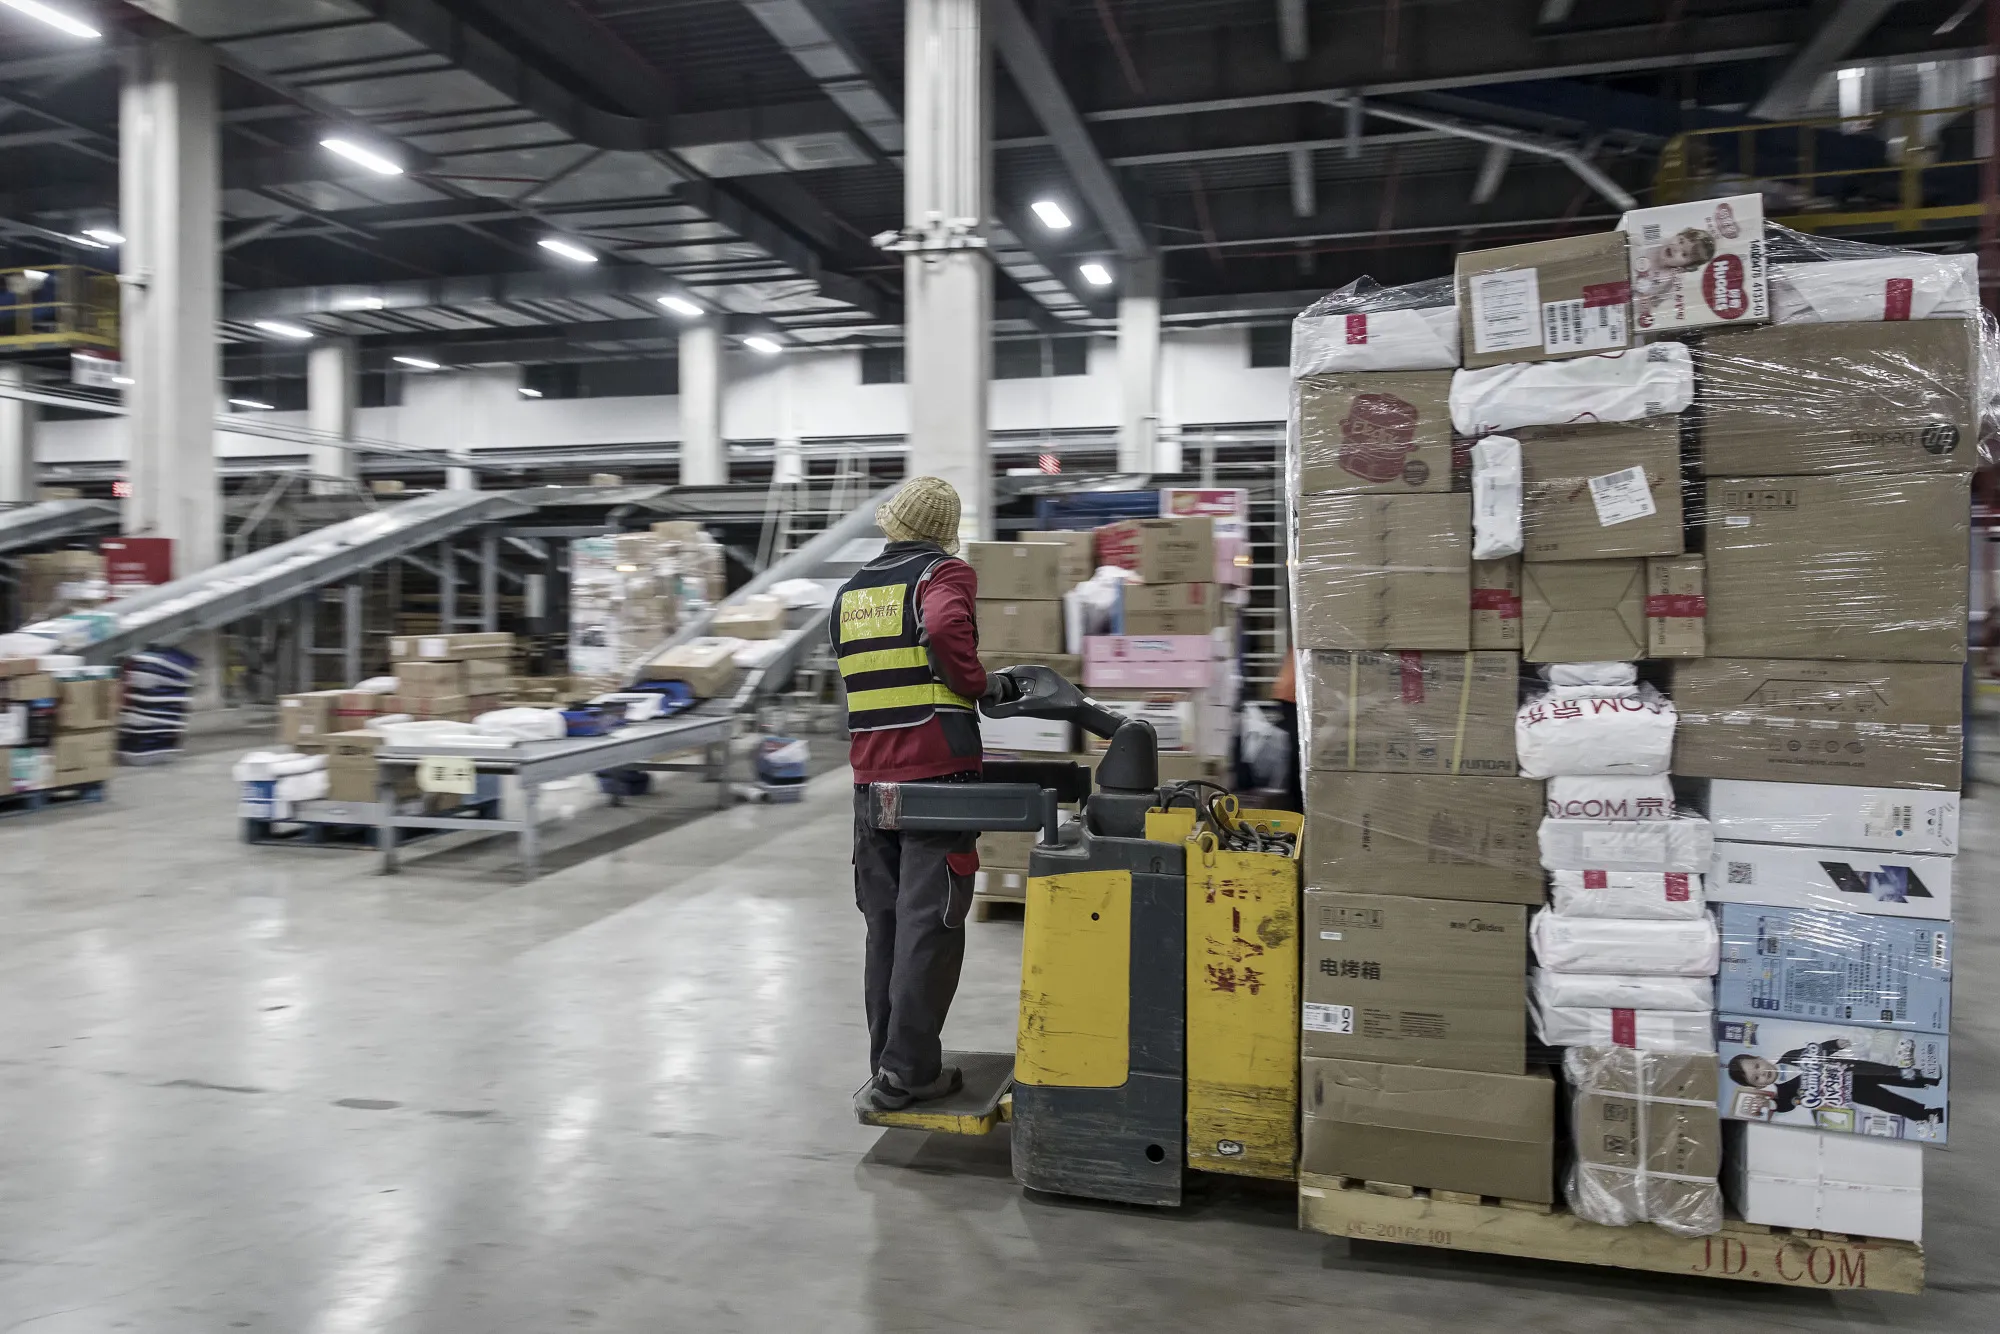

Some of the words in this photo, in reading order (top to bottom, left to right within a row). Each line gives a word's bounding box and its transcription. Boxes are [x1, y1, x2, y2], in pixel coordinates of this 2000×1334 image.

[874, 604, 898, 617] 京东
[1320, 958, 1381, 980] 电烤箱
[1341, 1020, 1351, 1032] 2
